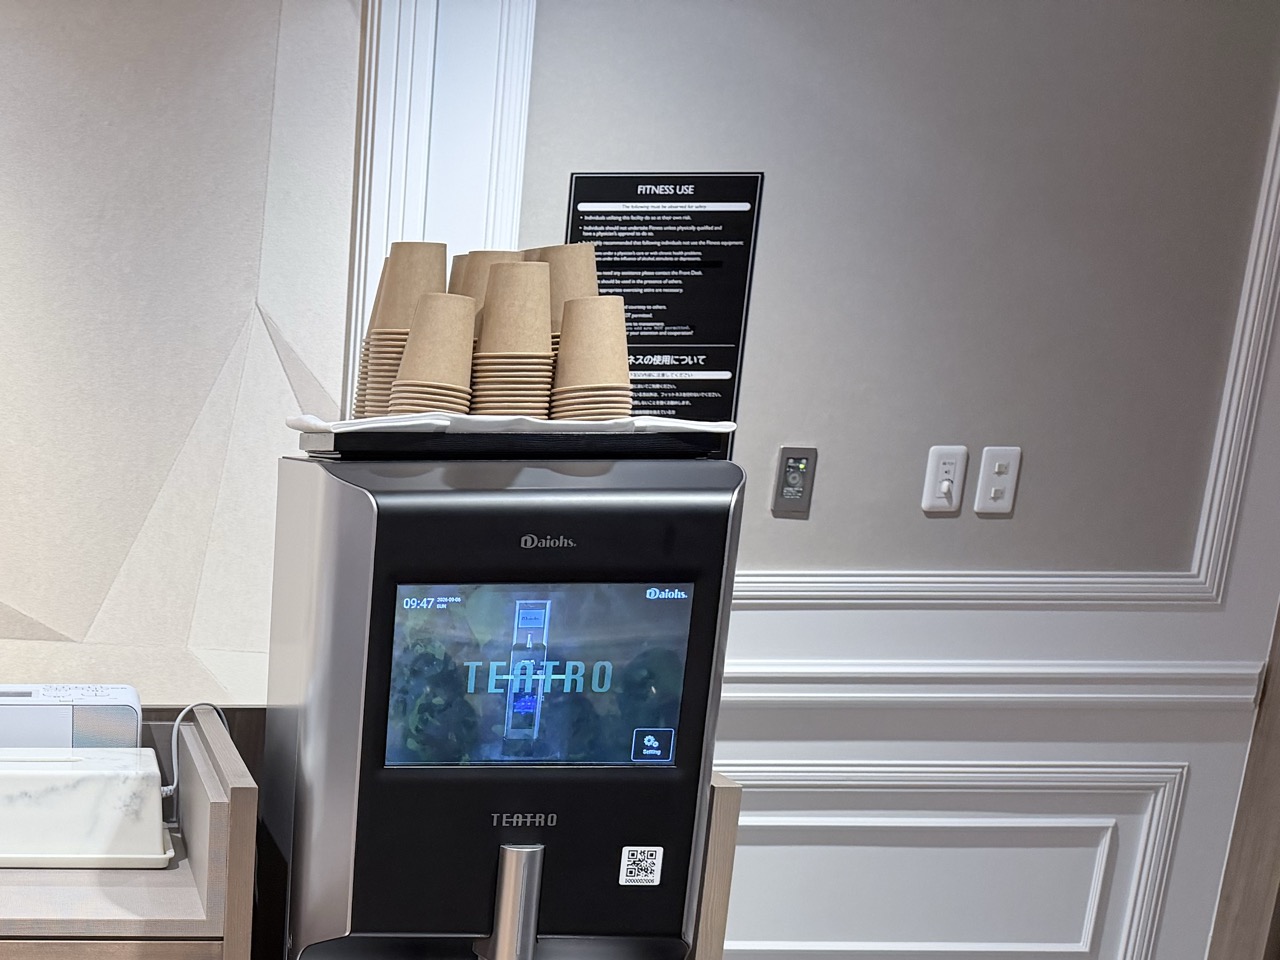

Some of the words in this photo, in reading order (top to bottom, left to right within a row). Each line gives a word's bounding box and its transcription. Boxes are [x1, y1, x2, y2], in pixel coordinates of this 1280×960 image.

[637, 185, 674, 194] FITNESS
[676, 185, 695, 194] USE
[404, 598, 435, 609] 09:47
[464, 661, 613, 693] TEATRO
[491, 814, 557, 827] TEATRO
